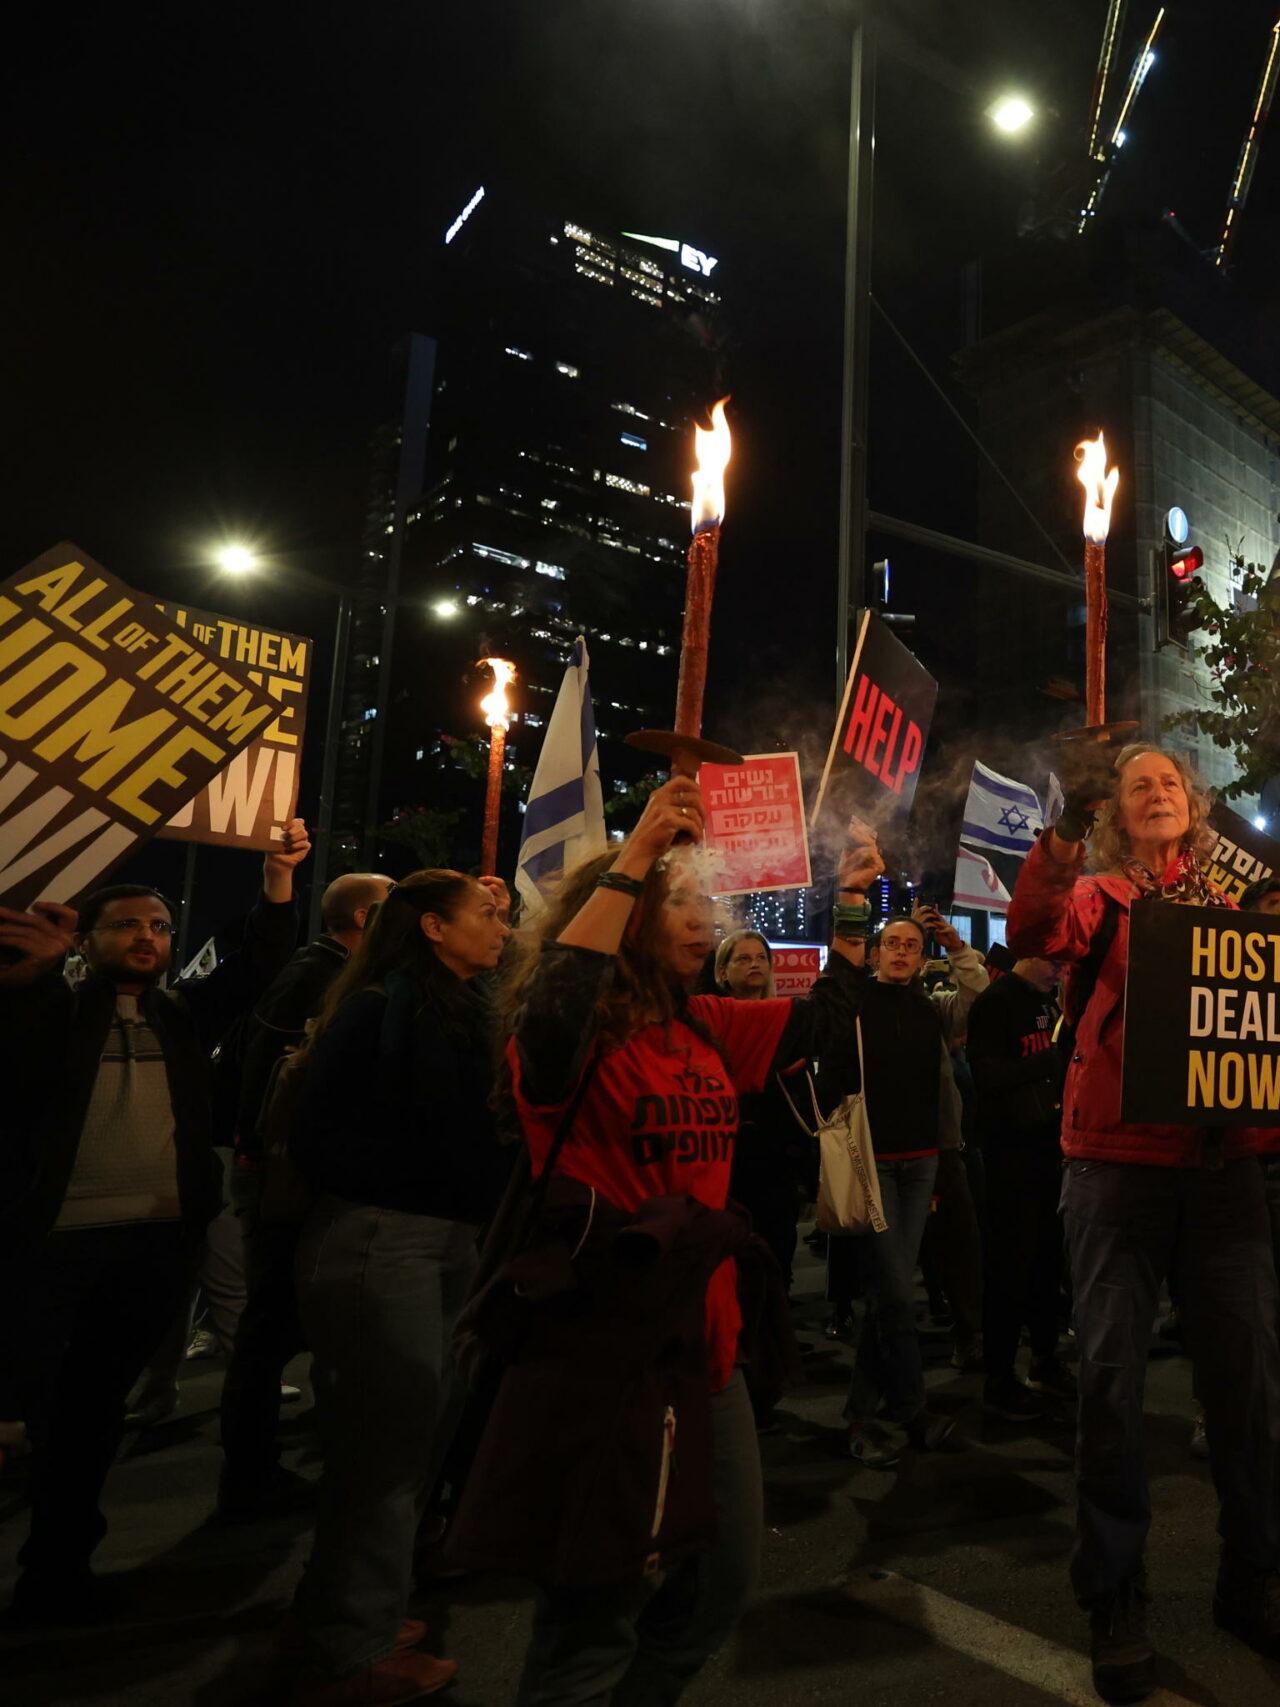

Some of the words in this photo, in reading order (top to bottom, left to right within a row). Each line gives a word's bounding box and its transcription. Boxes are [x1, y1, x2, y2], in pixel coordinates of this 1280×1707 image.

[681, 243, 718, 277] EY
[15, 560, 134, 651] ALL
[113, 621, 159, 654] OF
[136, 634, 273, 745] THEM
[217, 620, 306, 676] THEM
[843, 673, 923, 795] HELP
[710, 784, 789, 805] דורשות
[723, 769, 773, 788] נשים
[723, 810, 782, 828] עסקה
[631, 1094, 738, 1129] שפחות
